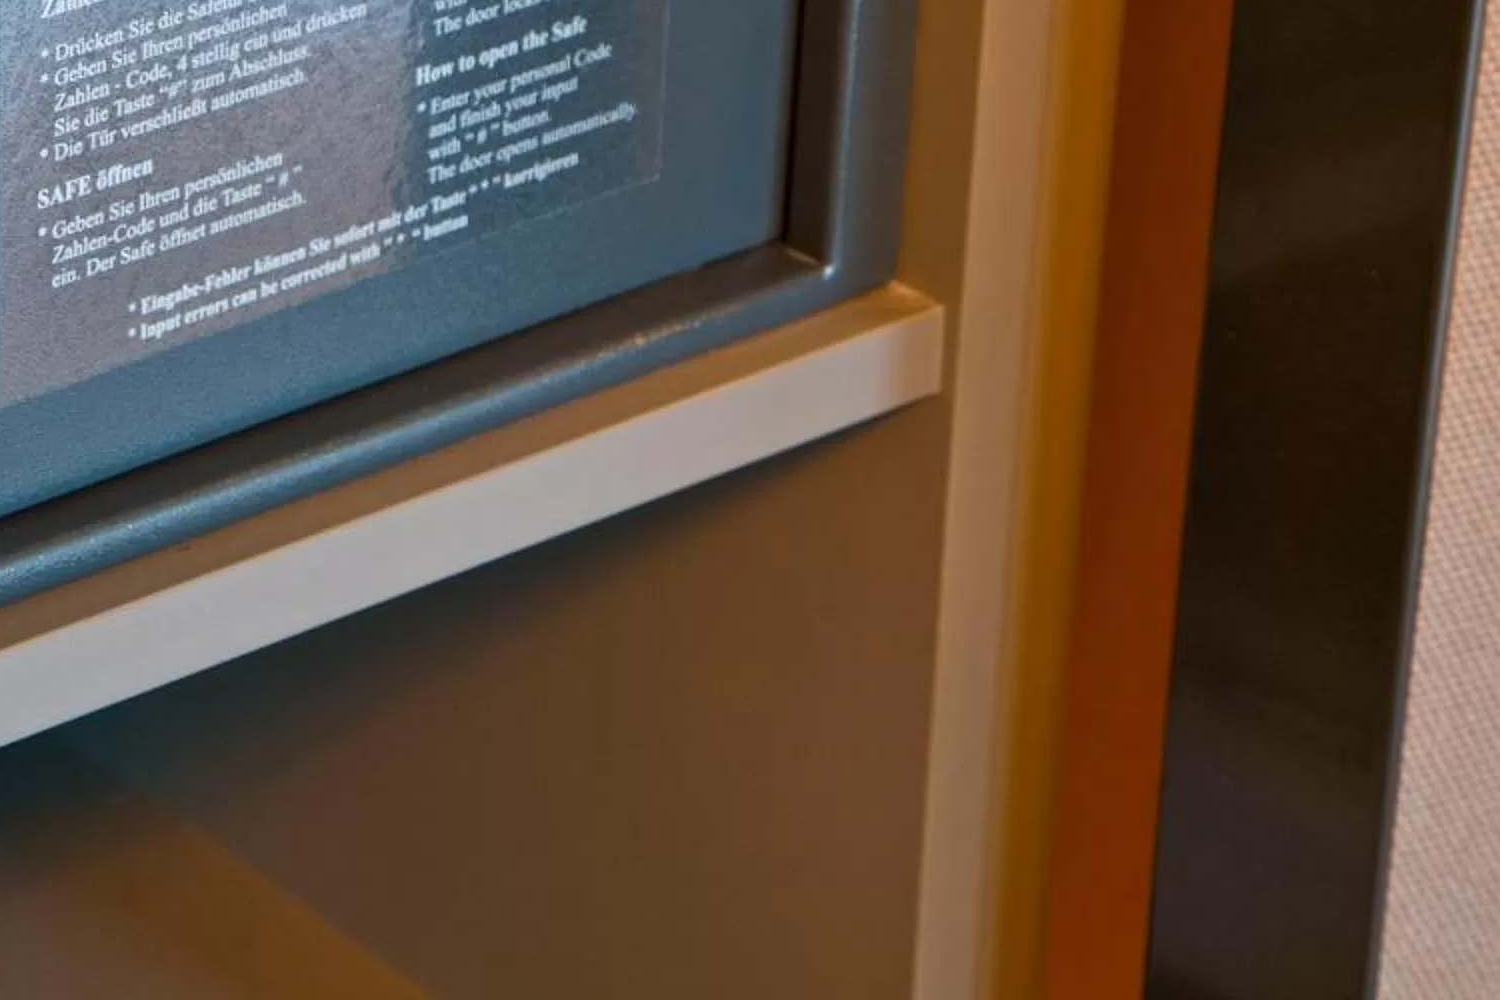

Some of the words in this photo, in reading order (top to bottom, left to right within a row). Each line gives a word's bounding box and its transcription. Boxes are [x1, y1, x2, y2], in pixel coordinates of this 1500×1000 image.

[54, 59, 107, 86] Geben
[111, 49, 137, 69] Sie
[142, 36, 182, 60] Ihren
[188, 4, 287, 49] persönlichen
[55, 29, 123, 61] Drücken
[129, 18, 156, 39] Sie
[159, 10, 181, 30] die
[415, 62, 454, 86] How
[457, 52, 475, 72] to
[478, 40, 519, 68] open
[522, 29, 548, 51] the
[551, 15, 587, 41] Safe
[434, 15, 461, 36] The
[464, 5, 499, 26] door
[54, 84, 110, 112] Zahlen
[126, 65, 172, 89] Code,
[192, 42, 239, 69] stellig
[243, 33, 268, 53] ein
[272, 21, 300, 44] und
[305, 4, 367, 34] drücken
[430, 91, 469, 115] Enter
[472, 79, 507, 105] your
[509, 53, 570, 93] personal
[572, 43, 612, 68] Code
[53, 116, 79, 135] Sie
[84, 107, 108, 126] die
[114, 92, 154, 116] Taste
[192, 72, 224, 92] zum
[54, 140, 82, 161] Die
[88, 129, 115, 150] Tür
[120, 97, 206, 140] verschließt
[428, 114, 456, 139] and
[459, 100, 500, 129] finish
[503, 91, 537, 118] your
[427, 136, 460, 161] with
[427, 162, 456, 184] The
[458, 151, 492, 174] door
[495, 135, 538, 163] opens
[37, 174, 91, 210] SAFE
[96, 159, 152, 190] öffnen
[51, 212, 104, 240] Geben
[108, 200, 134, 221] Sie
[139, 187, 180, 211] Ihren
[184, 152, 283, 200] persönlichen
[51, 218, 155, 264] Zahlen-Code
[159, 204, 188, 228] und
[193, 196, 217, 217] die
[222, 181, 261, 207] Taste
[51, 269, 81, 289] ein.
[86, 256, 116, 277] Der
[120, 242, 154, 265] Safe
[159, 222, 205, 252] öffnet
[140, 266, 250, 315] Eingabe-Fehler
[253, 248, 305, 276] können
[309, 237, 330, 256] Sie
[378, 210, 399, 232] mit
[404, 205, 427, 223] der
[430, 190, 466, 214] Taste
[140, 311, 180, 339] Input
[184, 299, 228, 324] errors
[231, 289, 256, 307] can
[260, 280, 278, 297] be
[281, 253, 346, 290] corrected
[350, 241, 380, 265] with
